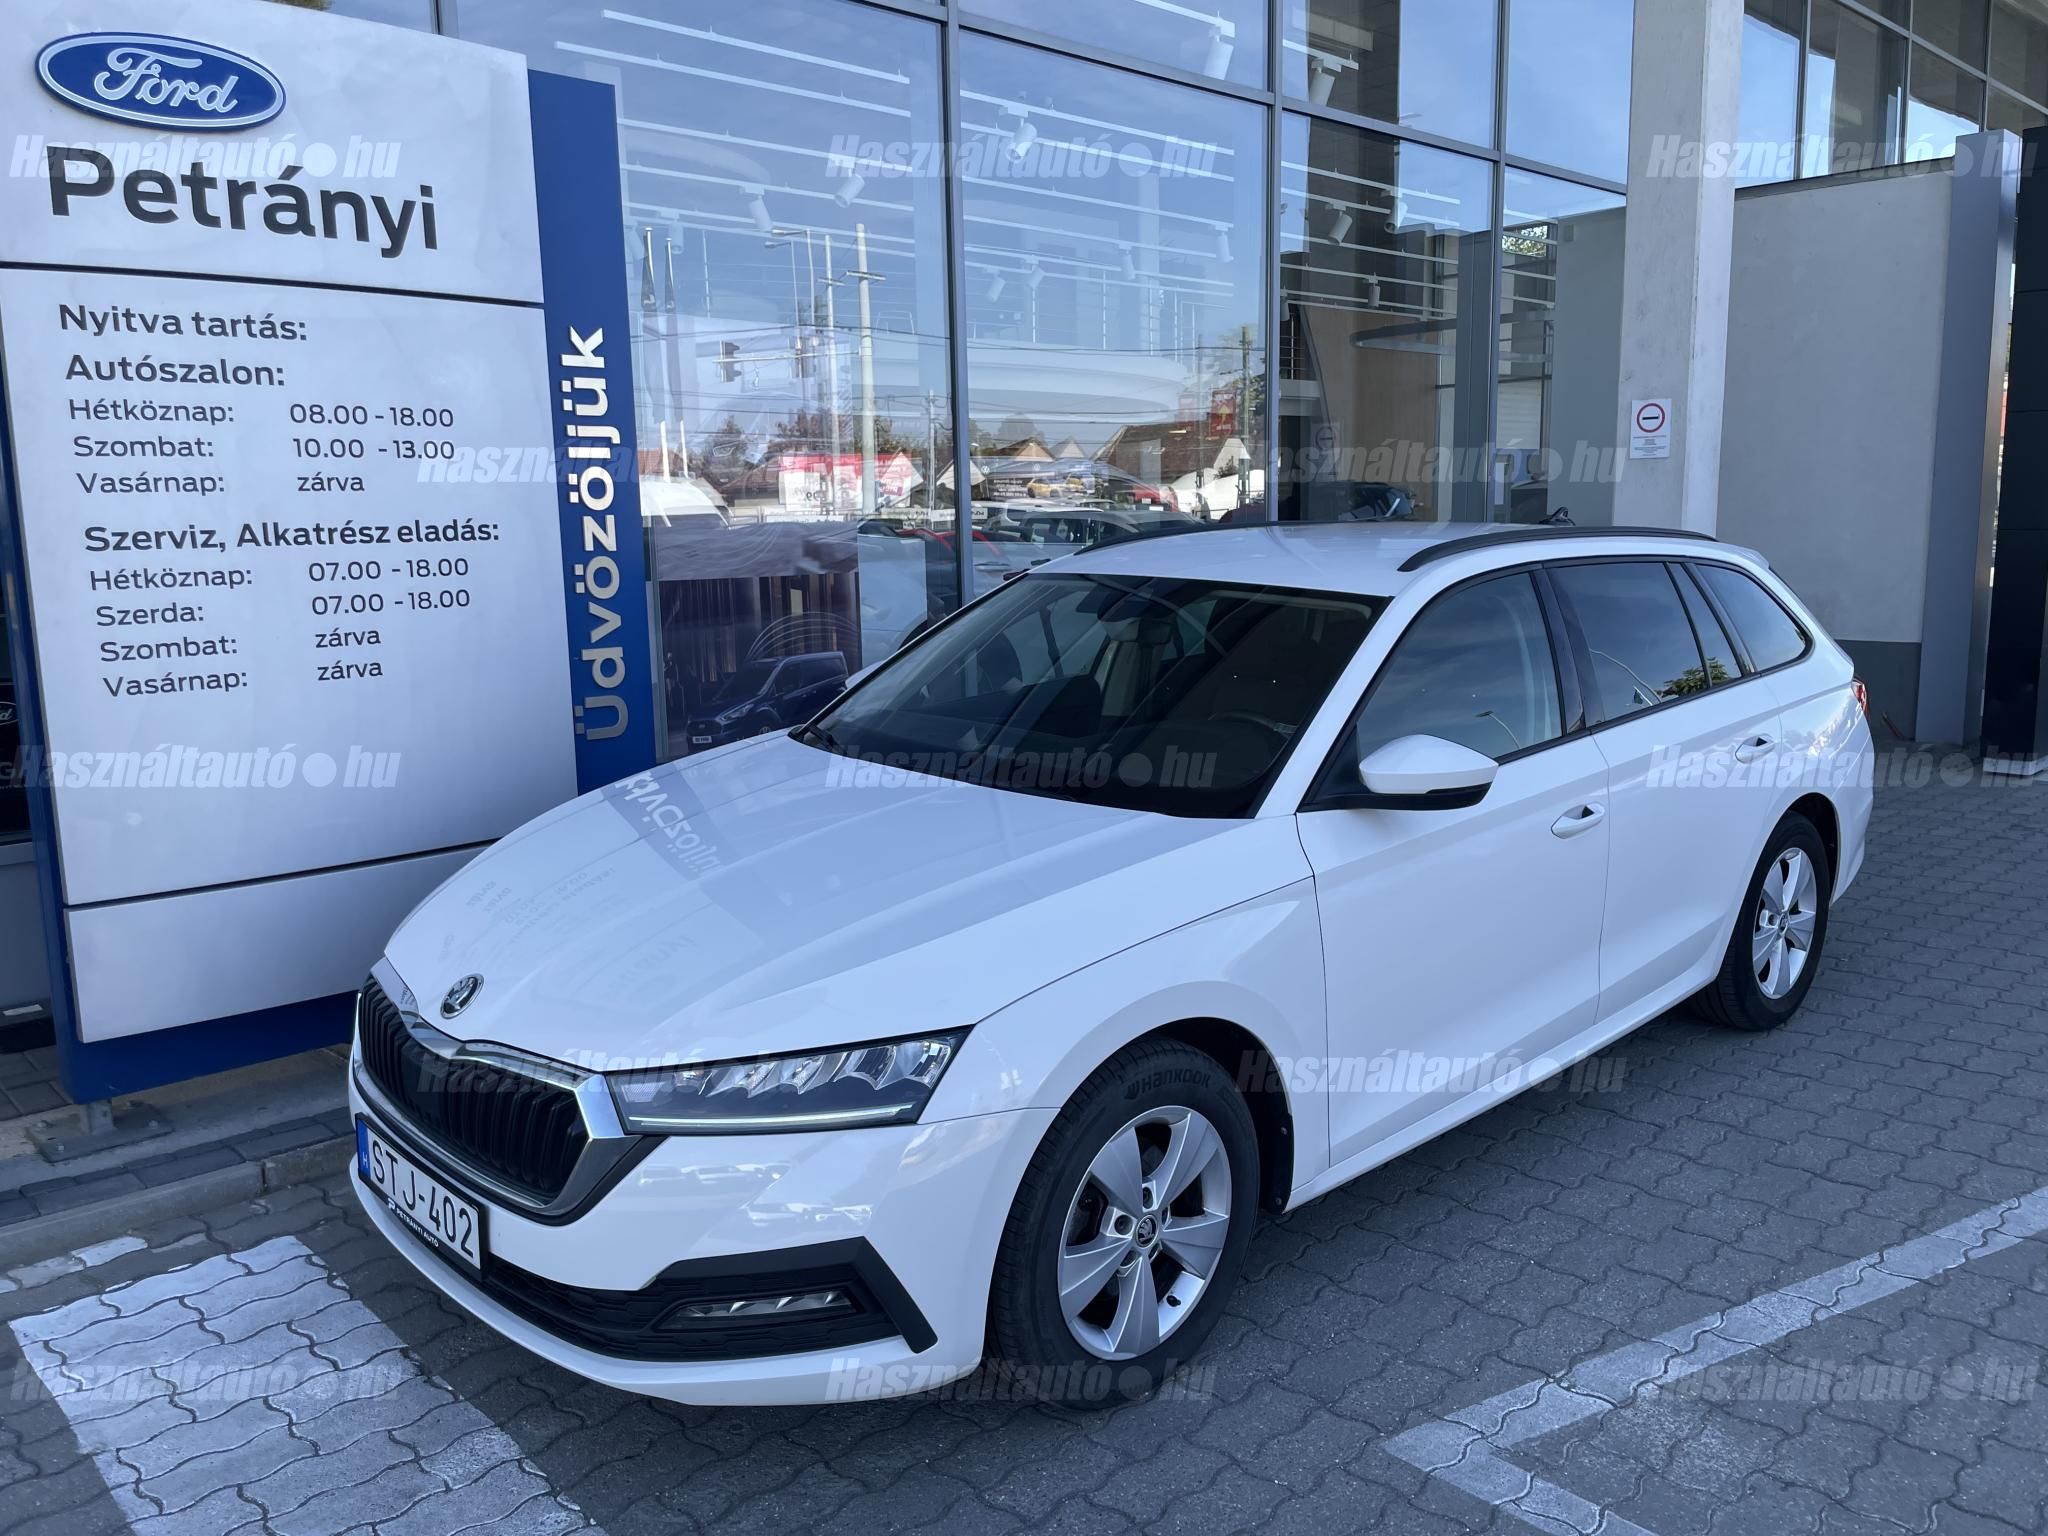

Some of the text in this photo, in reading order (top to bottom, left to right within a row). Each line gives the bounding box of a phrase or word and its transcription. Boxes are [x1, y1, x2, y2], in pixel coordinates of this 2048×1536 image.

[94, 47, 239, 113] Ford
[46, 145, 438, 259] Petrányi
[58, 303, 307, 341] Nyitva tartás:
[65, 354, 285, 387] Autószalon:
[69, 398, 234, 426] Hétköznap:
[289, 403, 368, 425] 08.00
[73, 435, 214, 458] Szombat:
[292, 437, 365, 459] 10.00
[76, 471, 366, 497] Vasárnap: zárva
[84, 517, 500, 553] Szerviz, Alkatrész eladás:
[560, 326, 629, 740] Üdvözöljük
[90, 567, 253, 591] Hétköznap:
[308, 561, 382, 582] 07.00
[96, 601, 204, 627] Szerda:
[311, 594, 384, 615] 07.00
[100, 627, 382, 663] Szombat: zárva
[103, 659, 384, 698] Vasárnap: zárva
[372, 1140, 474, 1258] STJ-402
